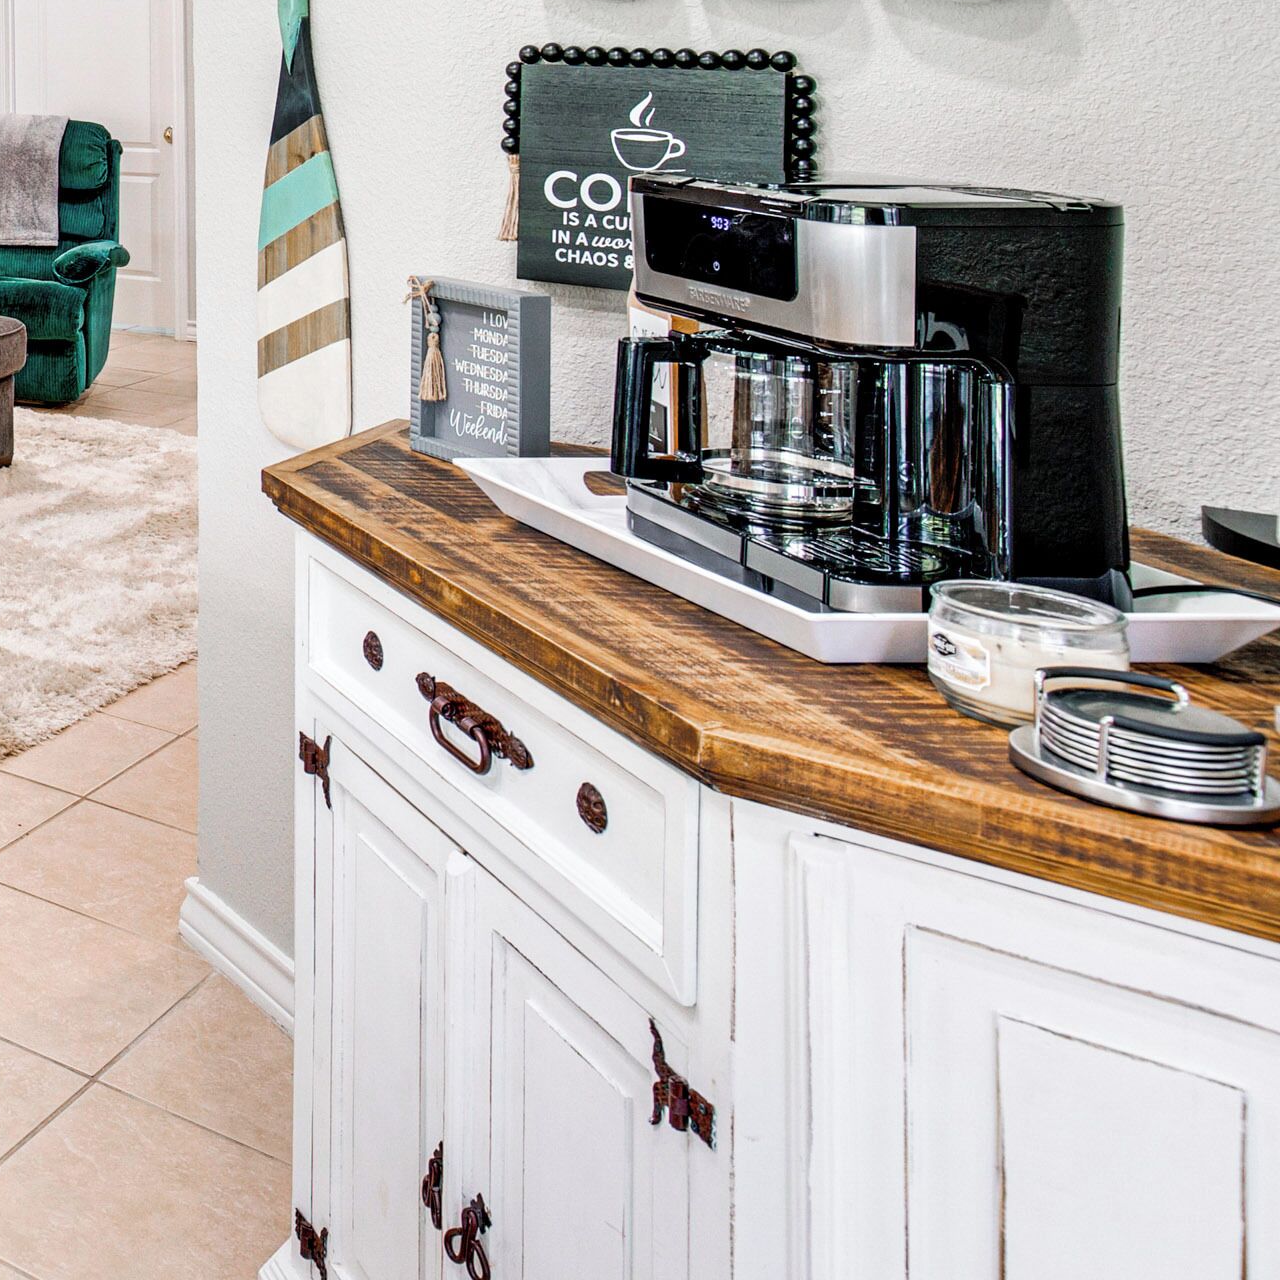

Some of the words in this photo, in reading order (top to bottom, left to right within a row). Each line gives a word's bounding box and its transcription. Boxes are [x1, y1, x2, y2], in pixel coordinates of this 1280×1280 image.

[562, 211, 579, 227] IS
[585, 214, 598, 229] A
[552, 229, 571, 246] IN
[575, 231, 589, 247] A
[591, 235, 634, 252] wor
[555, 248, 618, 268] CHAOS
[483, 312, 487, 325] I
[490, 313, 508, 329] LOV
